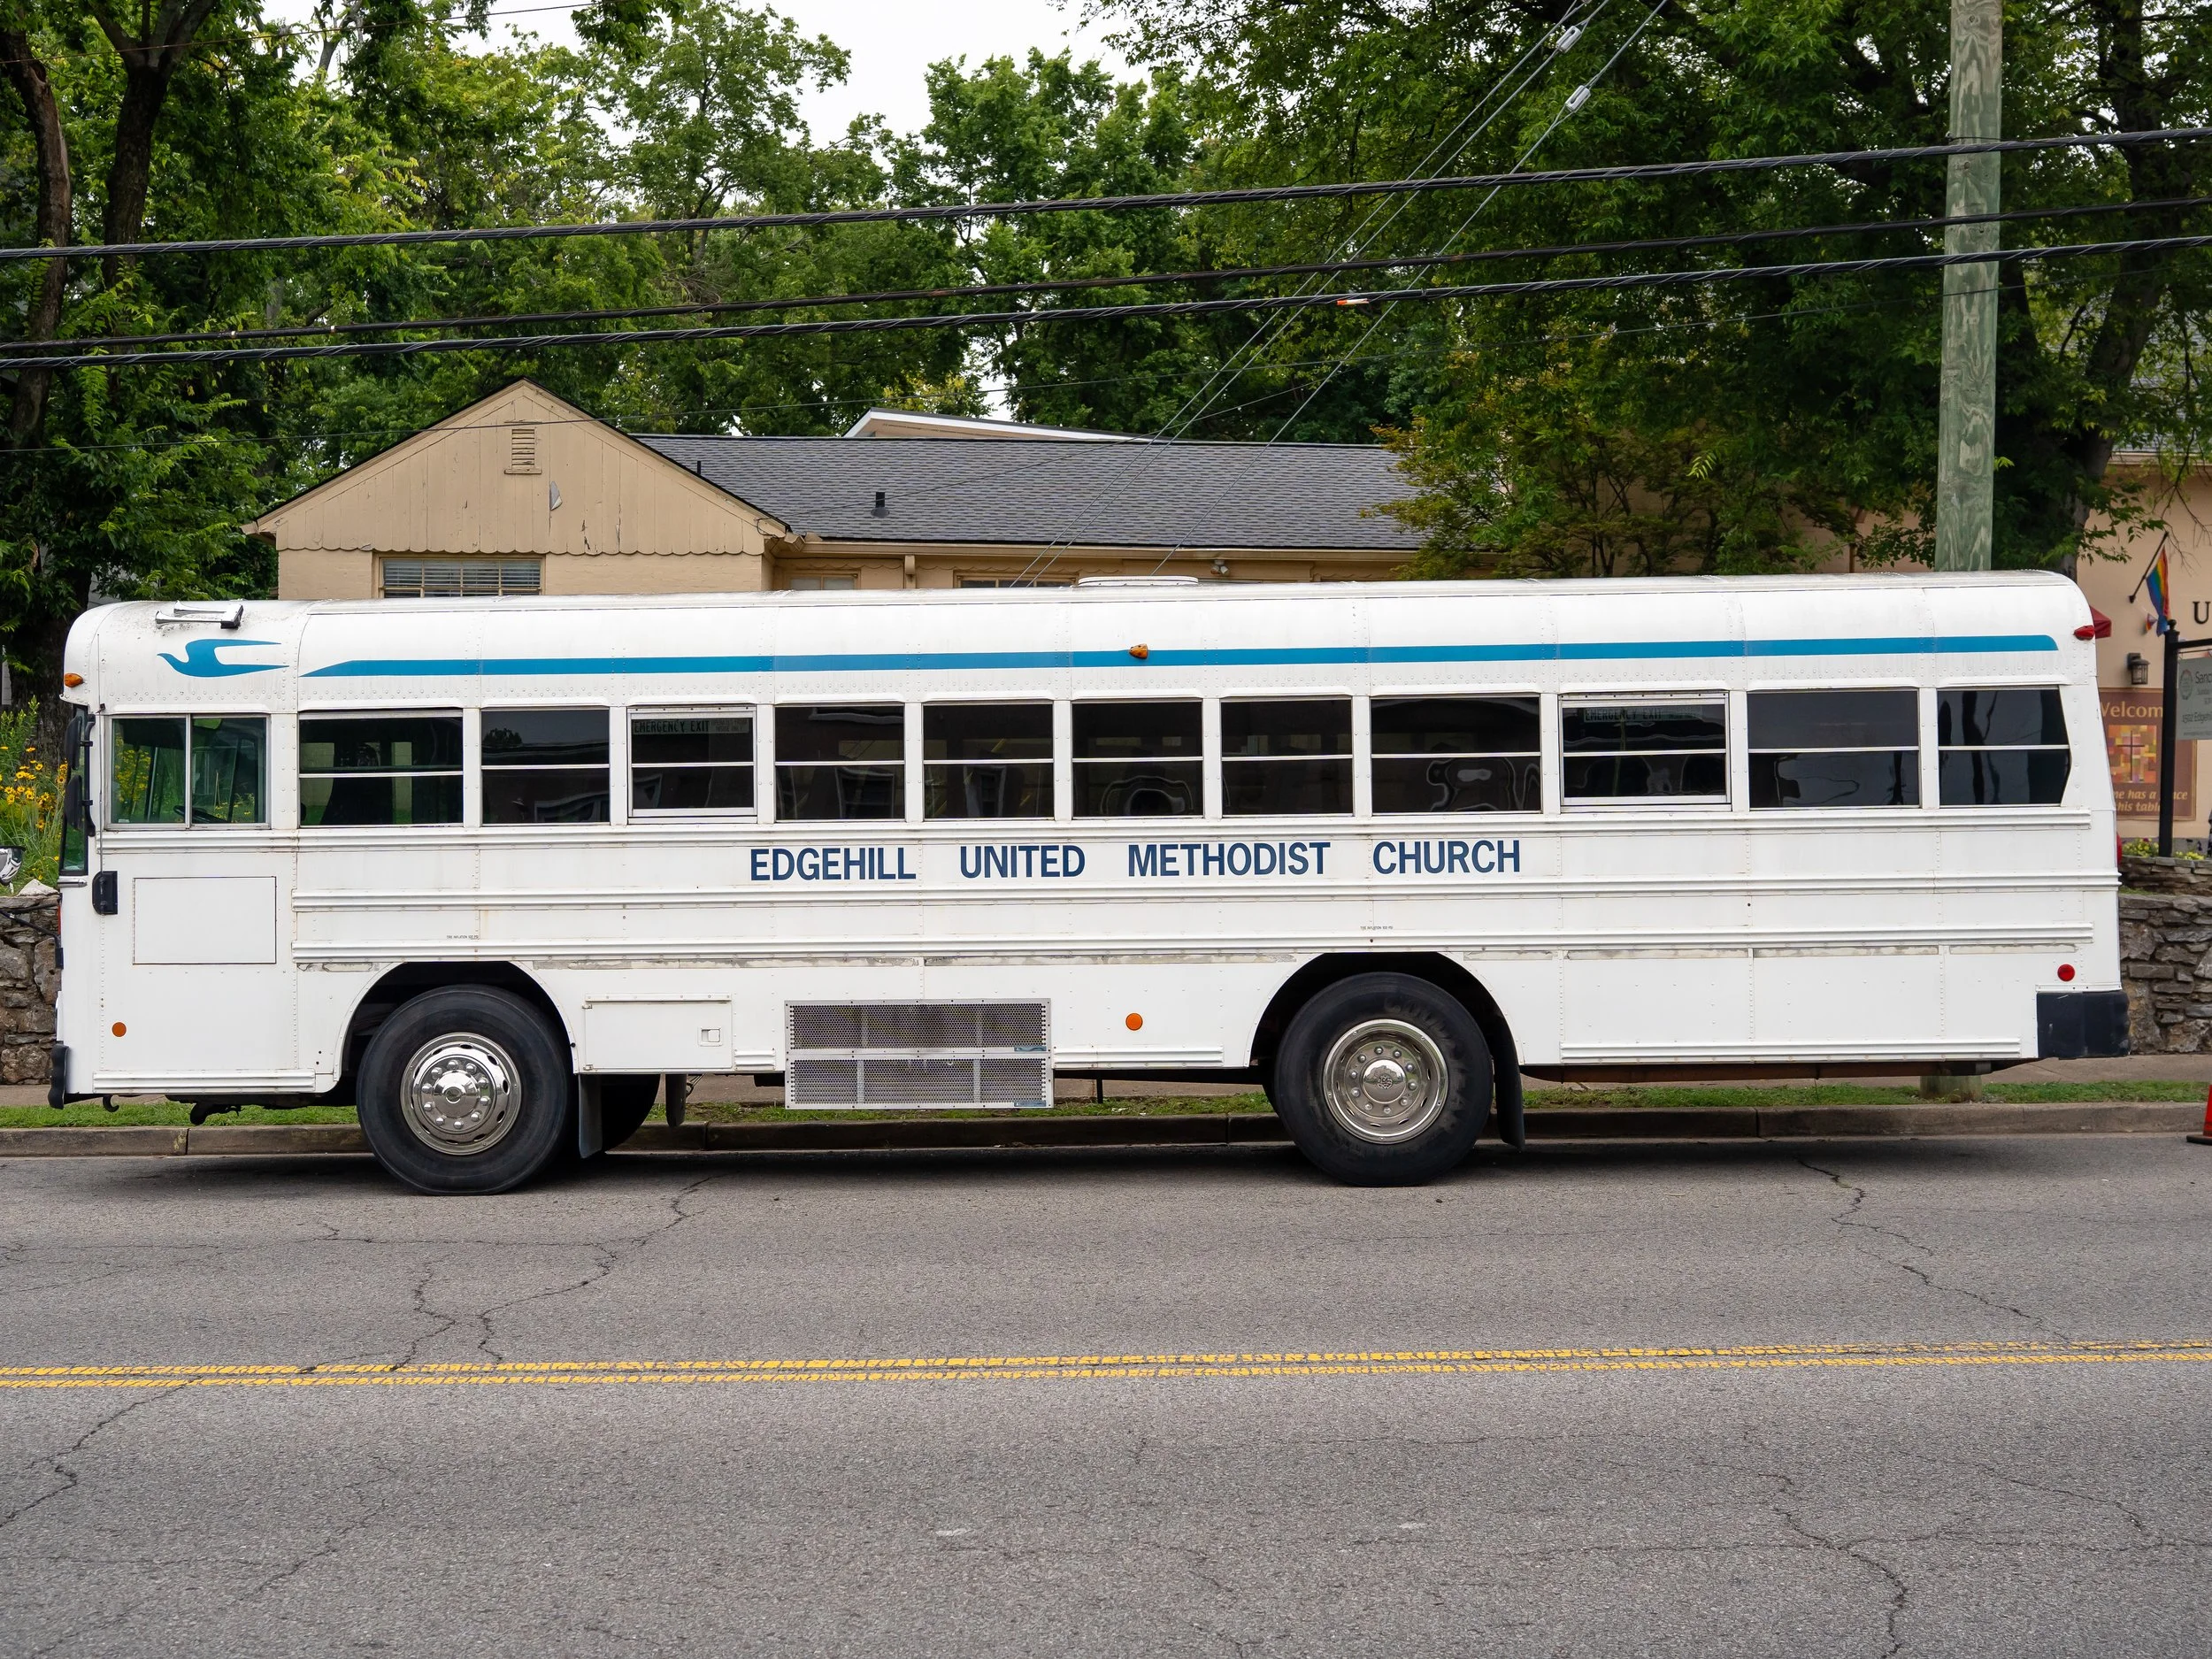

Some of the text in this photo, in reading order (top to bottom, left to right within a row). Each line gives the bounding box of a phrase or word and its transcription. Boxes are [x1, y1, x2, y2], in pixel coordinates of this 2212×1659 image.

[2193, 601, 2211, 625] U
[1585, 708, 1637, 721] EMERGENCY
[1642, 707, 1662, 719] EXIT
[2101, 701, 2163, 718] elcom
[634, 720, 685, 733] EMERGENCY
[690, 720, 710, 733] EXIT
[2127, 789, 2147, 800] has
[2149, 791, 2156, 800] a
[2117, 802, 2161, 811] his tabl
[750, 839, 1521, 881] EDGEHILL UNITED METHODIST CHURCH
